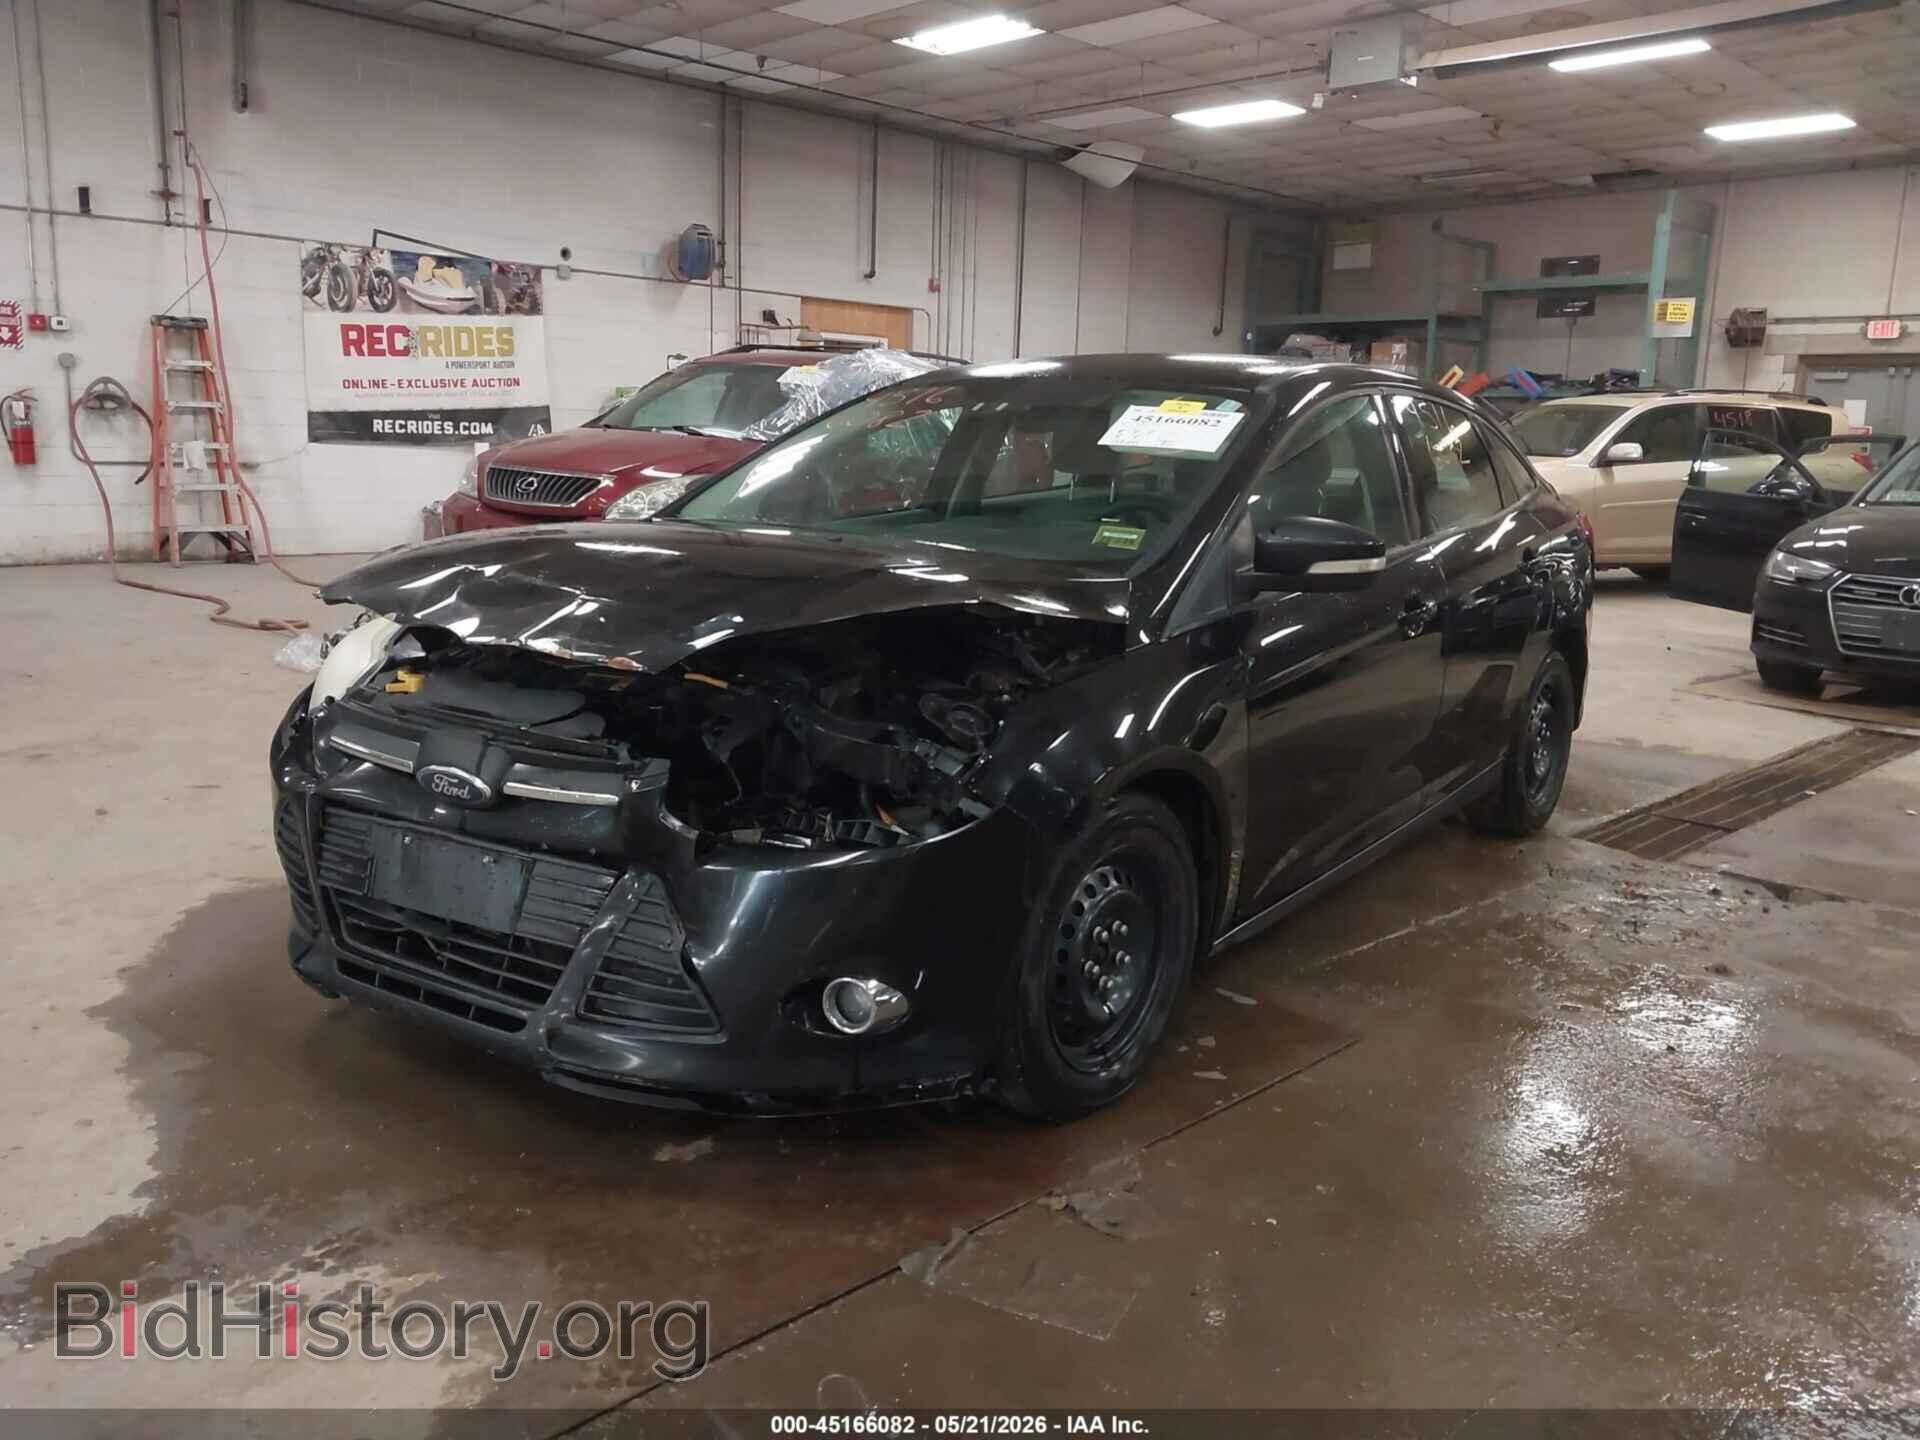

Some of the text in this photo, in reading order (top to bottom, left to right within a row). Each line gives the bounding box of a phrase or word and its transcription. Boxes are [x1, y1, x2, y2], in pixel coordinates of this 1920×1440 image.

[1872, 321, 1897, 337] EXIT
[340, 323, 514, 357] REC RIDES
[451, 361, 491, 369] POWERSPORT
[493, 361, 515, 369] AUCTION
[342, 377, 521, 389] ONLINE-EXCLUSIVE AUCTION
[372, 418, 494, 435] RECRIDES.COM
[431, 773, 472, 800] Ford
